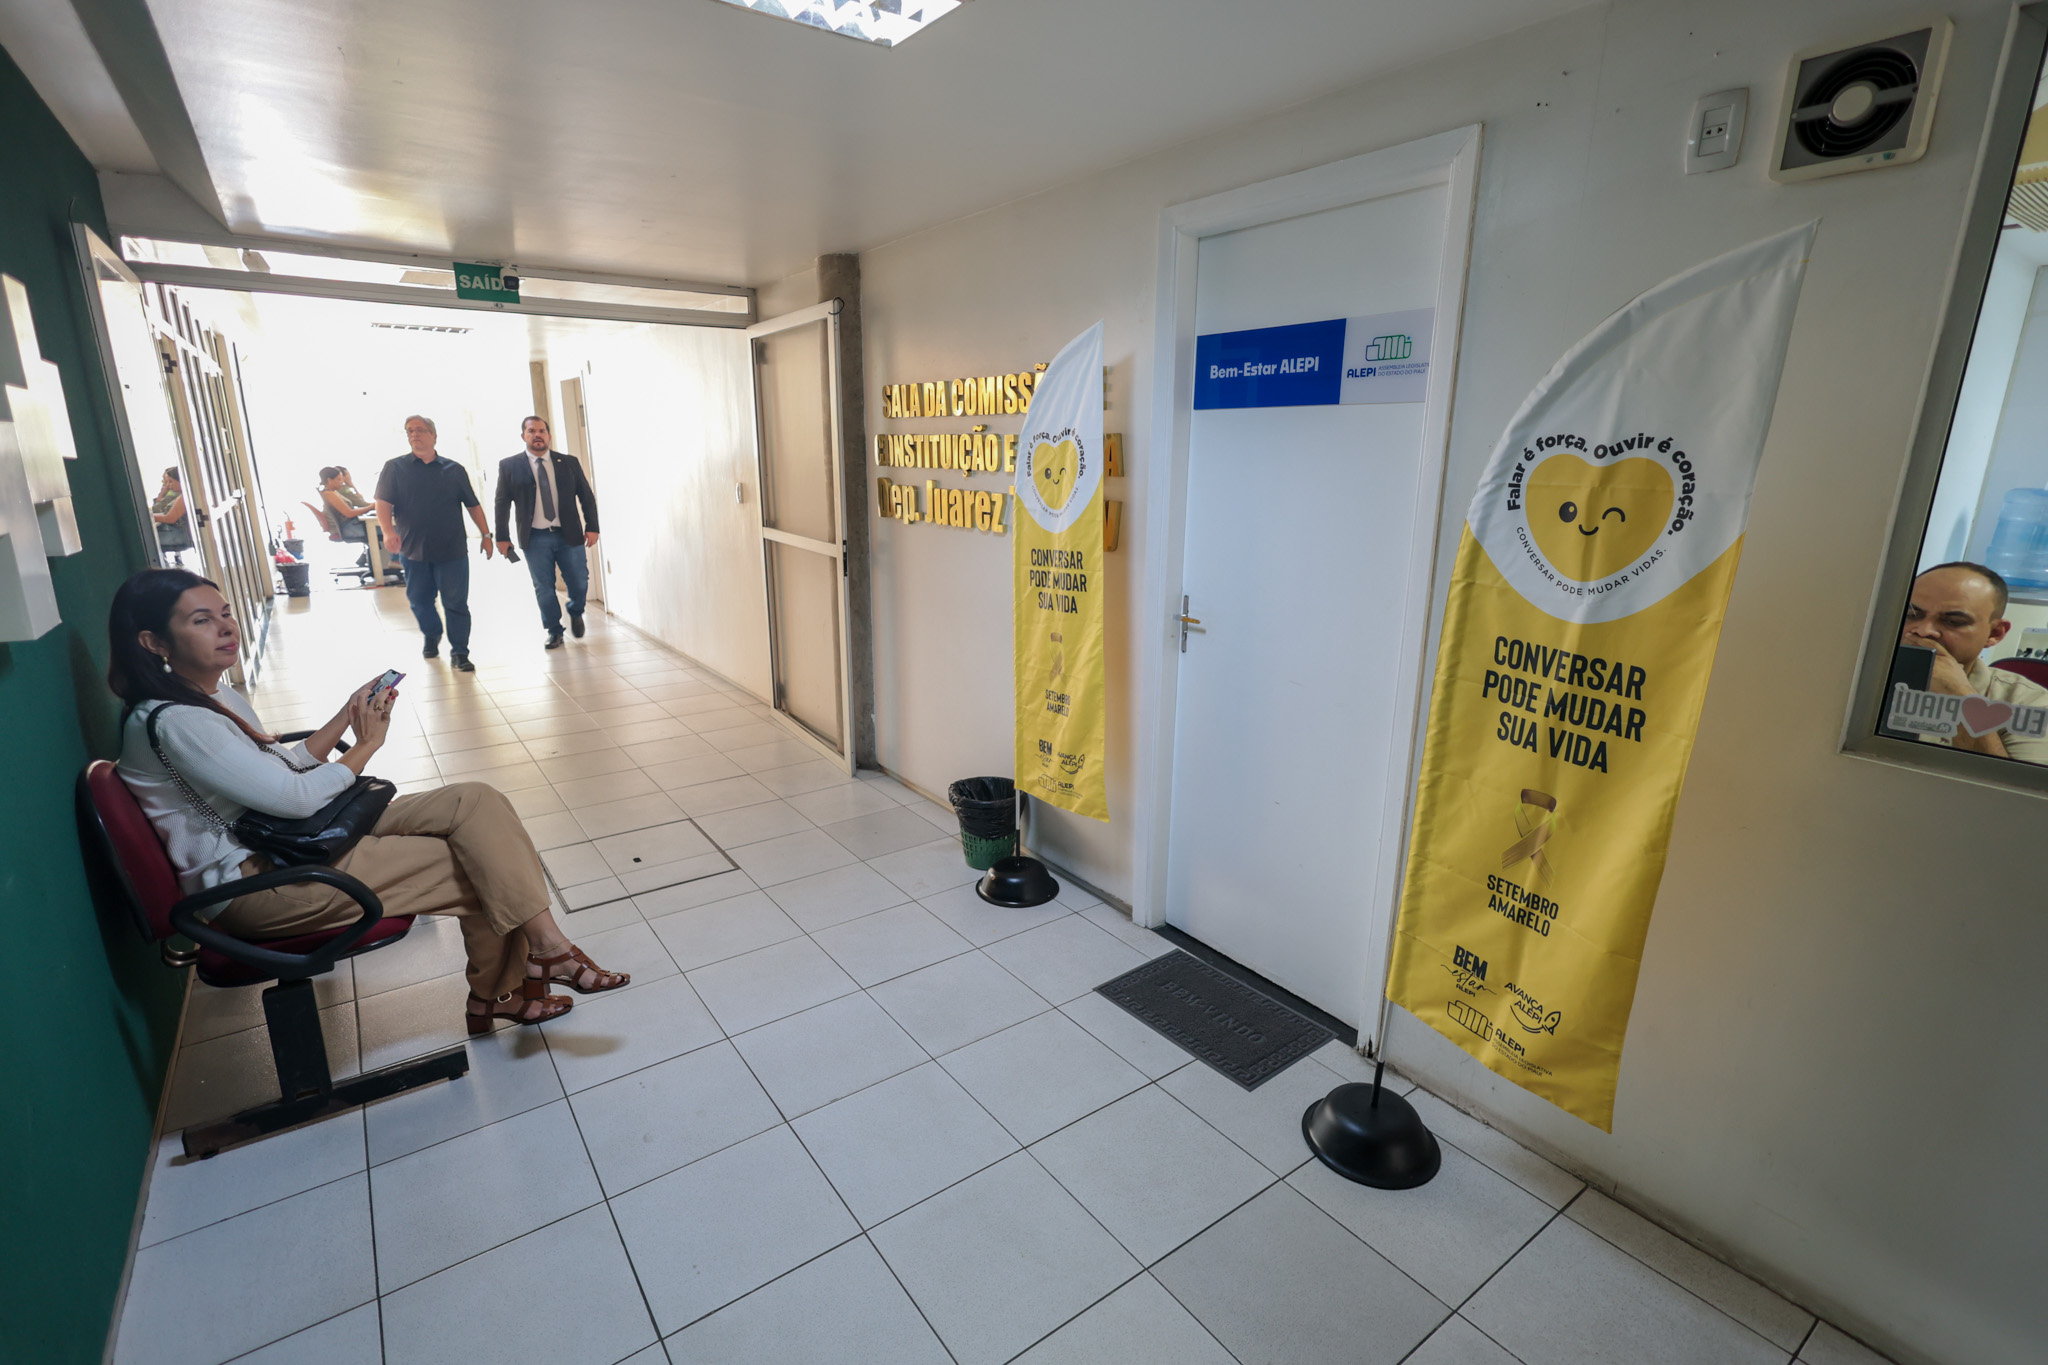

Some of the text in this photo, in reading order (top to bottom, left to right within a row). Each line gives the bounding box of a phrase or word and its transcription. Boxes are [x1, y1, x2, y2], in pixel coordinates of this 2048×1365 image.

[459, 273, 518, 292] SAÍD
[1210, 356, 1320, 379] Bem-Estar ALEPI
[1346, 367, 1376, 378] ALEPI
[882, 363, 1050, 418] SALA DA COMISS
[875, 424, 1002, 477] CONSTITUIÇÃO
[1507, 433, 1696, 536] Falar é força. Ouvir é coração.
[877, 477, 1007, 533] Dep. Juarez
[1031, 548, 1083, 570] CONVERSAR
[1516, 526, 1667, 596] CONVERSAR PODE MUDAR VIDAS.
[1029, 569, 1087, 592] PODE MUDAR
[1038, 591, 1078, 614] SUA VIDA
[1494, 636, 1647, 701] CONVERSAR
[1045, 689, 1070, 706] SETEMBRO
[1046, 701, 1069, 717] AMARELO
[1482, 669, 1647, 742] PODE MUDAR
[1497, 711, 1608, 774] SUA VIDA
[1487, 874, 1559, 920] SETEMBRO
[1488, 894, 1550, 937] AMARELO
[1453, 944, 1488, 981] BEM
[1456, 983, 1475, 997] ALEPI
[1504, 982, 1543, 1014] AVANÇA
[1514, 1000, 1542, 1024] ALEPI
[1495, 1028, 1525, 1056] ALEPI
